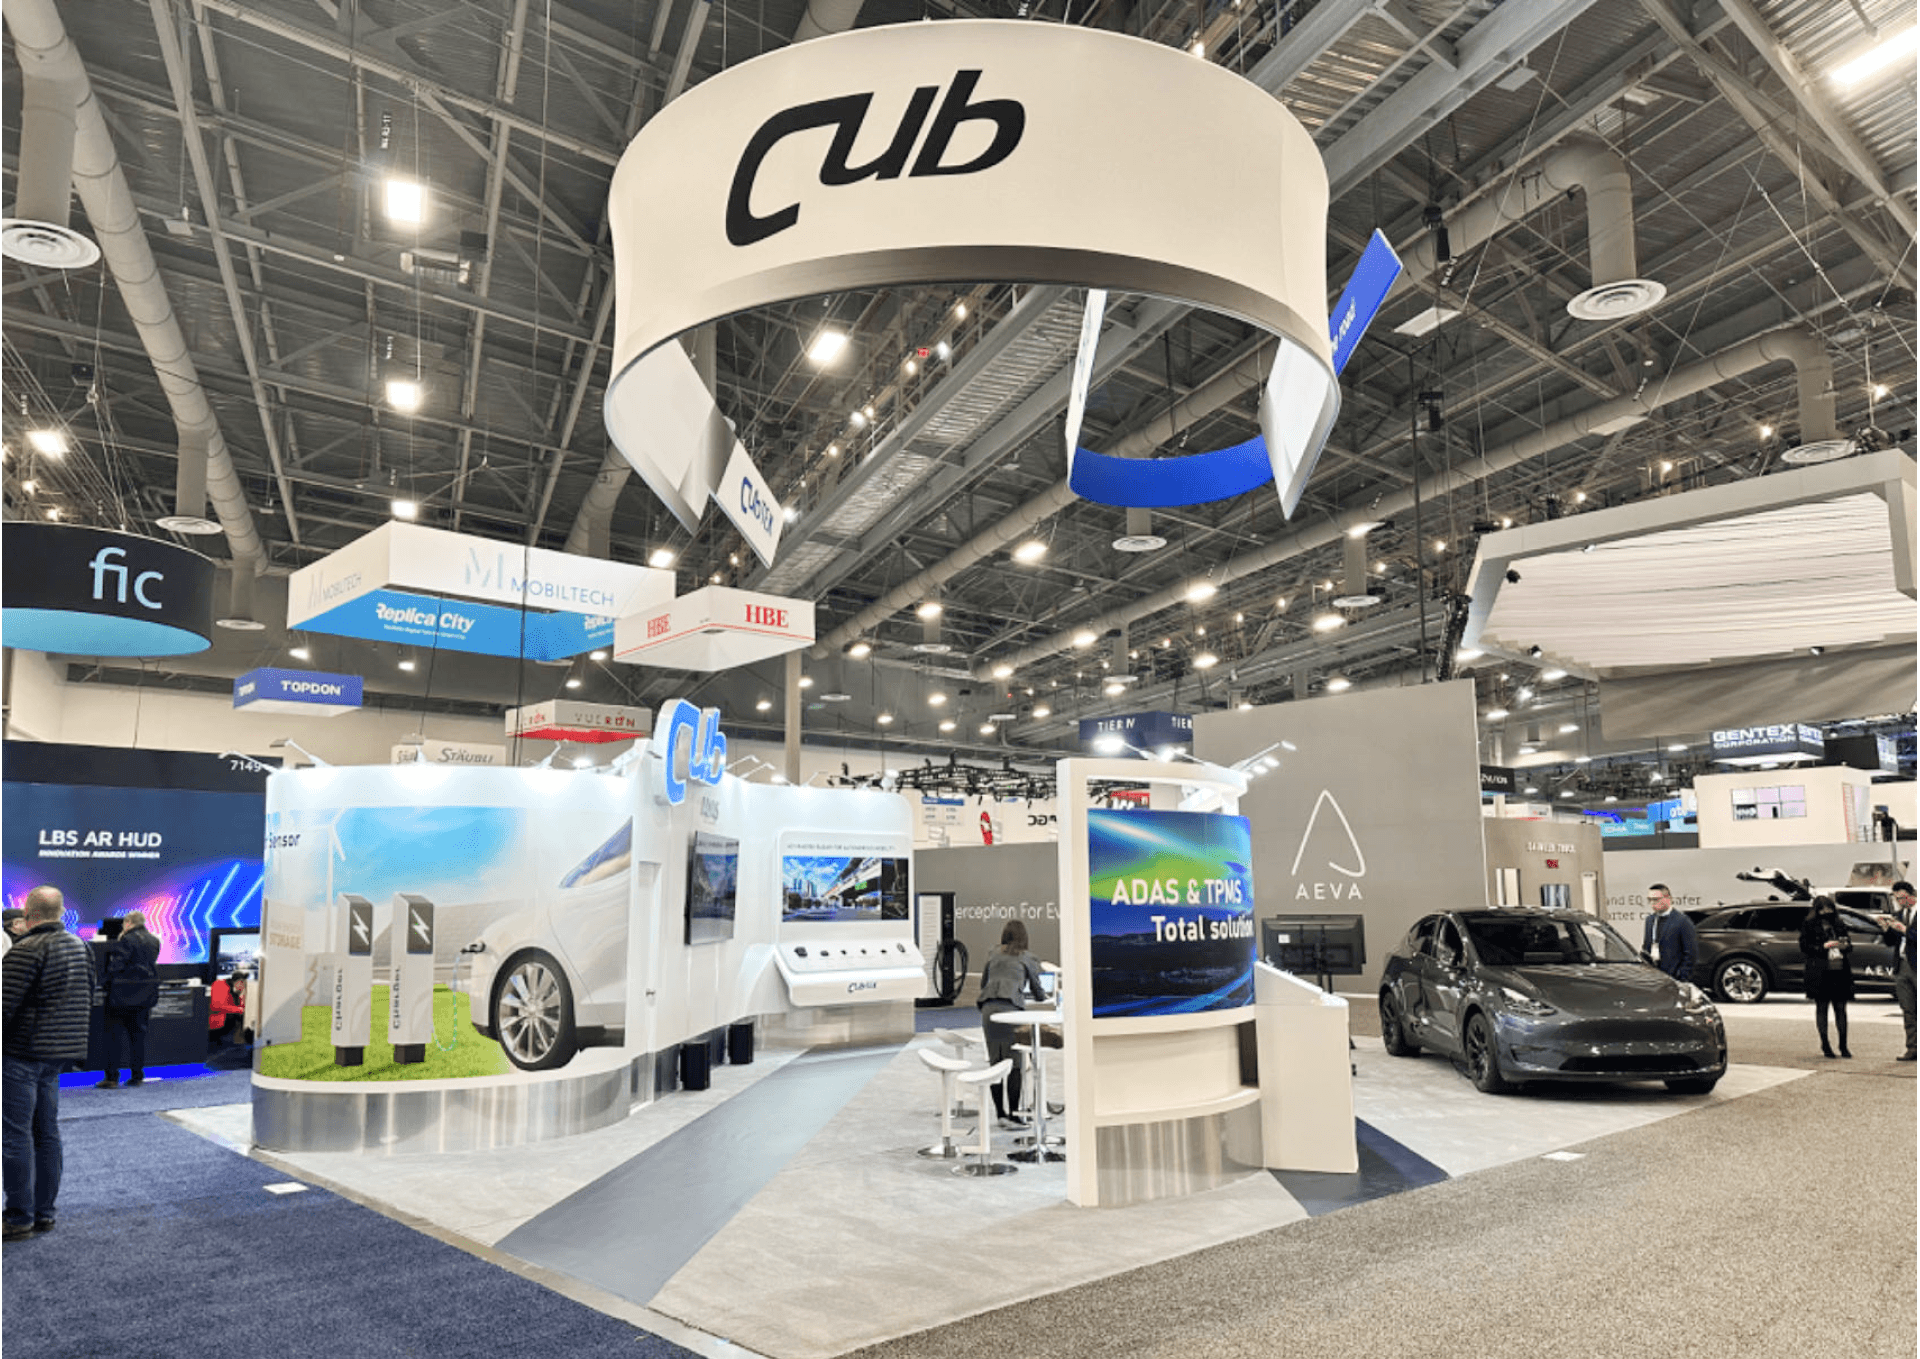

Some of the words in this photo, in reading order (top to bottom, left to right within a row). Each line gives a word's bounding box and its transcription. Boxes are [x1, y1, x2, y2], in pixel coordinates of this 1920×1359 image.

[88, 546, 164, 610] fic
[511, 577, 614, 606] MOBILTECH
[375, 602, 436, 627] Replica
[439, 612, 476, 633] City
[745, 603, 790, 629] HBE
[281, 680, 342, 696] TOPDON
[1713, 724, 1796, 742] GENTEX
[1714, 736, 1796, 749] CORPORATION
[230, 760, 262, 773] 7149
[39, 829, 79, 846] LBS
[83, 830, 113, 847] AR
[118, 831, 162, 848] HUD
[1110, 878, 1179, 905] ADAS
[1186, 879, 1201, 905] &
[1204, 879, 1242, 905] TPMS
[1295, 882, 1363, 900] AEVA
[955, 902, 1016, 922] erception
[1020, 903, 1042, 919] For
[1151, 915, 1204, 942] Total
[1865, 965, 1895, 976] AEV
